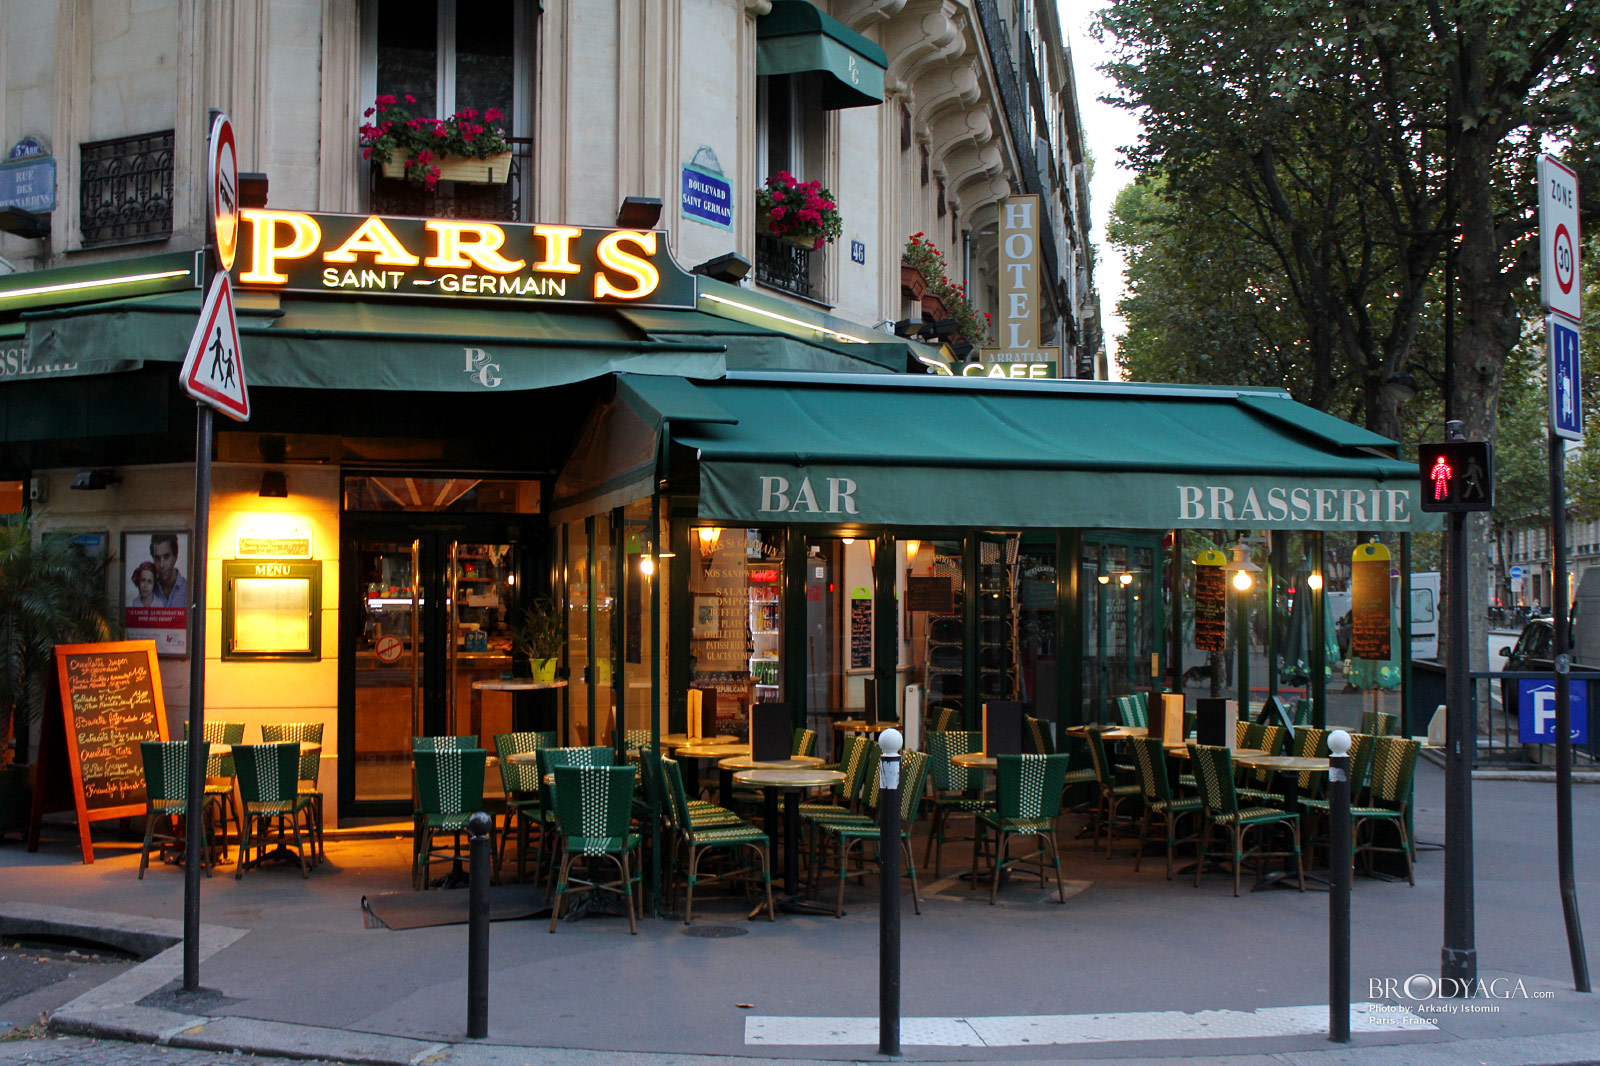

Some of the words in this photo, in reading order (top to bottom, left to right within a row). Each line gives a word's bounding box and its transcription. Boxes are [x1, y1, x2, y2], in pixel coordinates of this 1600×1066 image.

[16, 170, 33, 182] RUE
[17, 184, 32, 194] DES
[688, 178, 726, 200] BOULEVARD
[1551, 179, 1573, 209] ZONE
[682, 194, 702, 204] SAINT
[703, 198, 731, 218] GERMAIN
[237, 208, 660, 300] PARIS
[1558, 245, 1570, 272] 30
[1004, 203, 1033, 349] HOTEL
[757, 476, 860, 515] BAR
[1177, 485, 1412, 523] BRASSERIE
[255, 563, 291, 576] MENU
[704, 569, 720, 578] NOS
